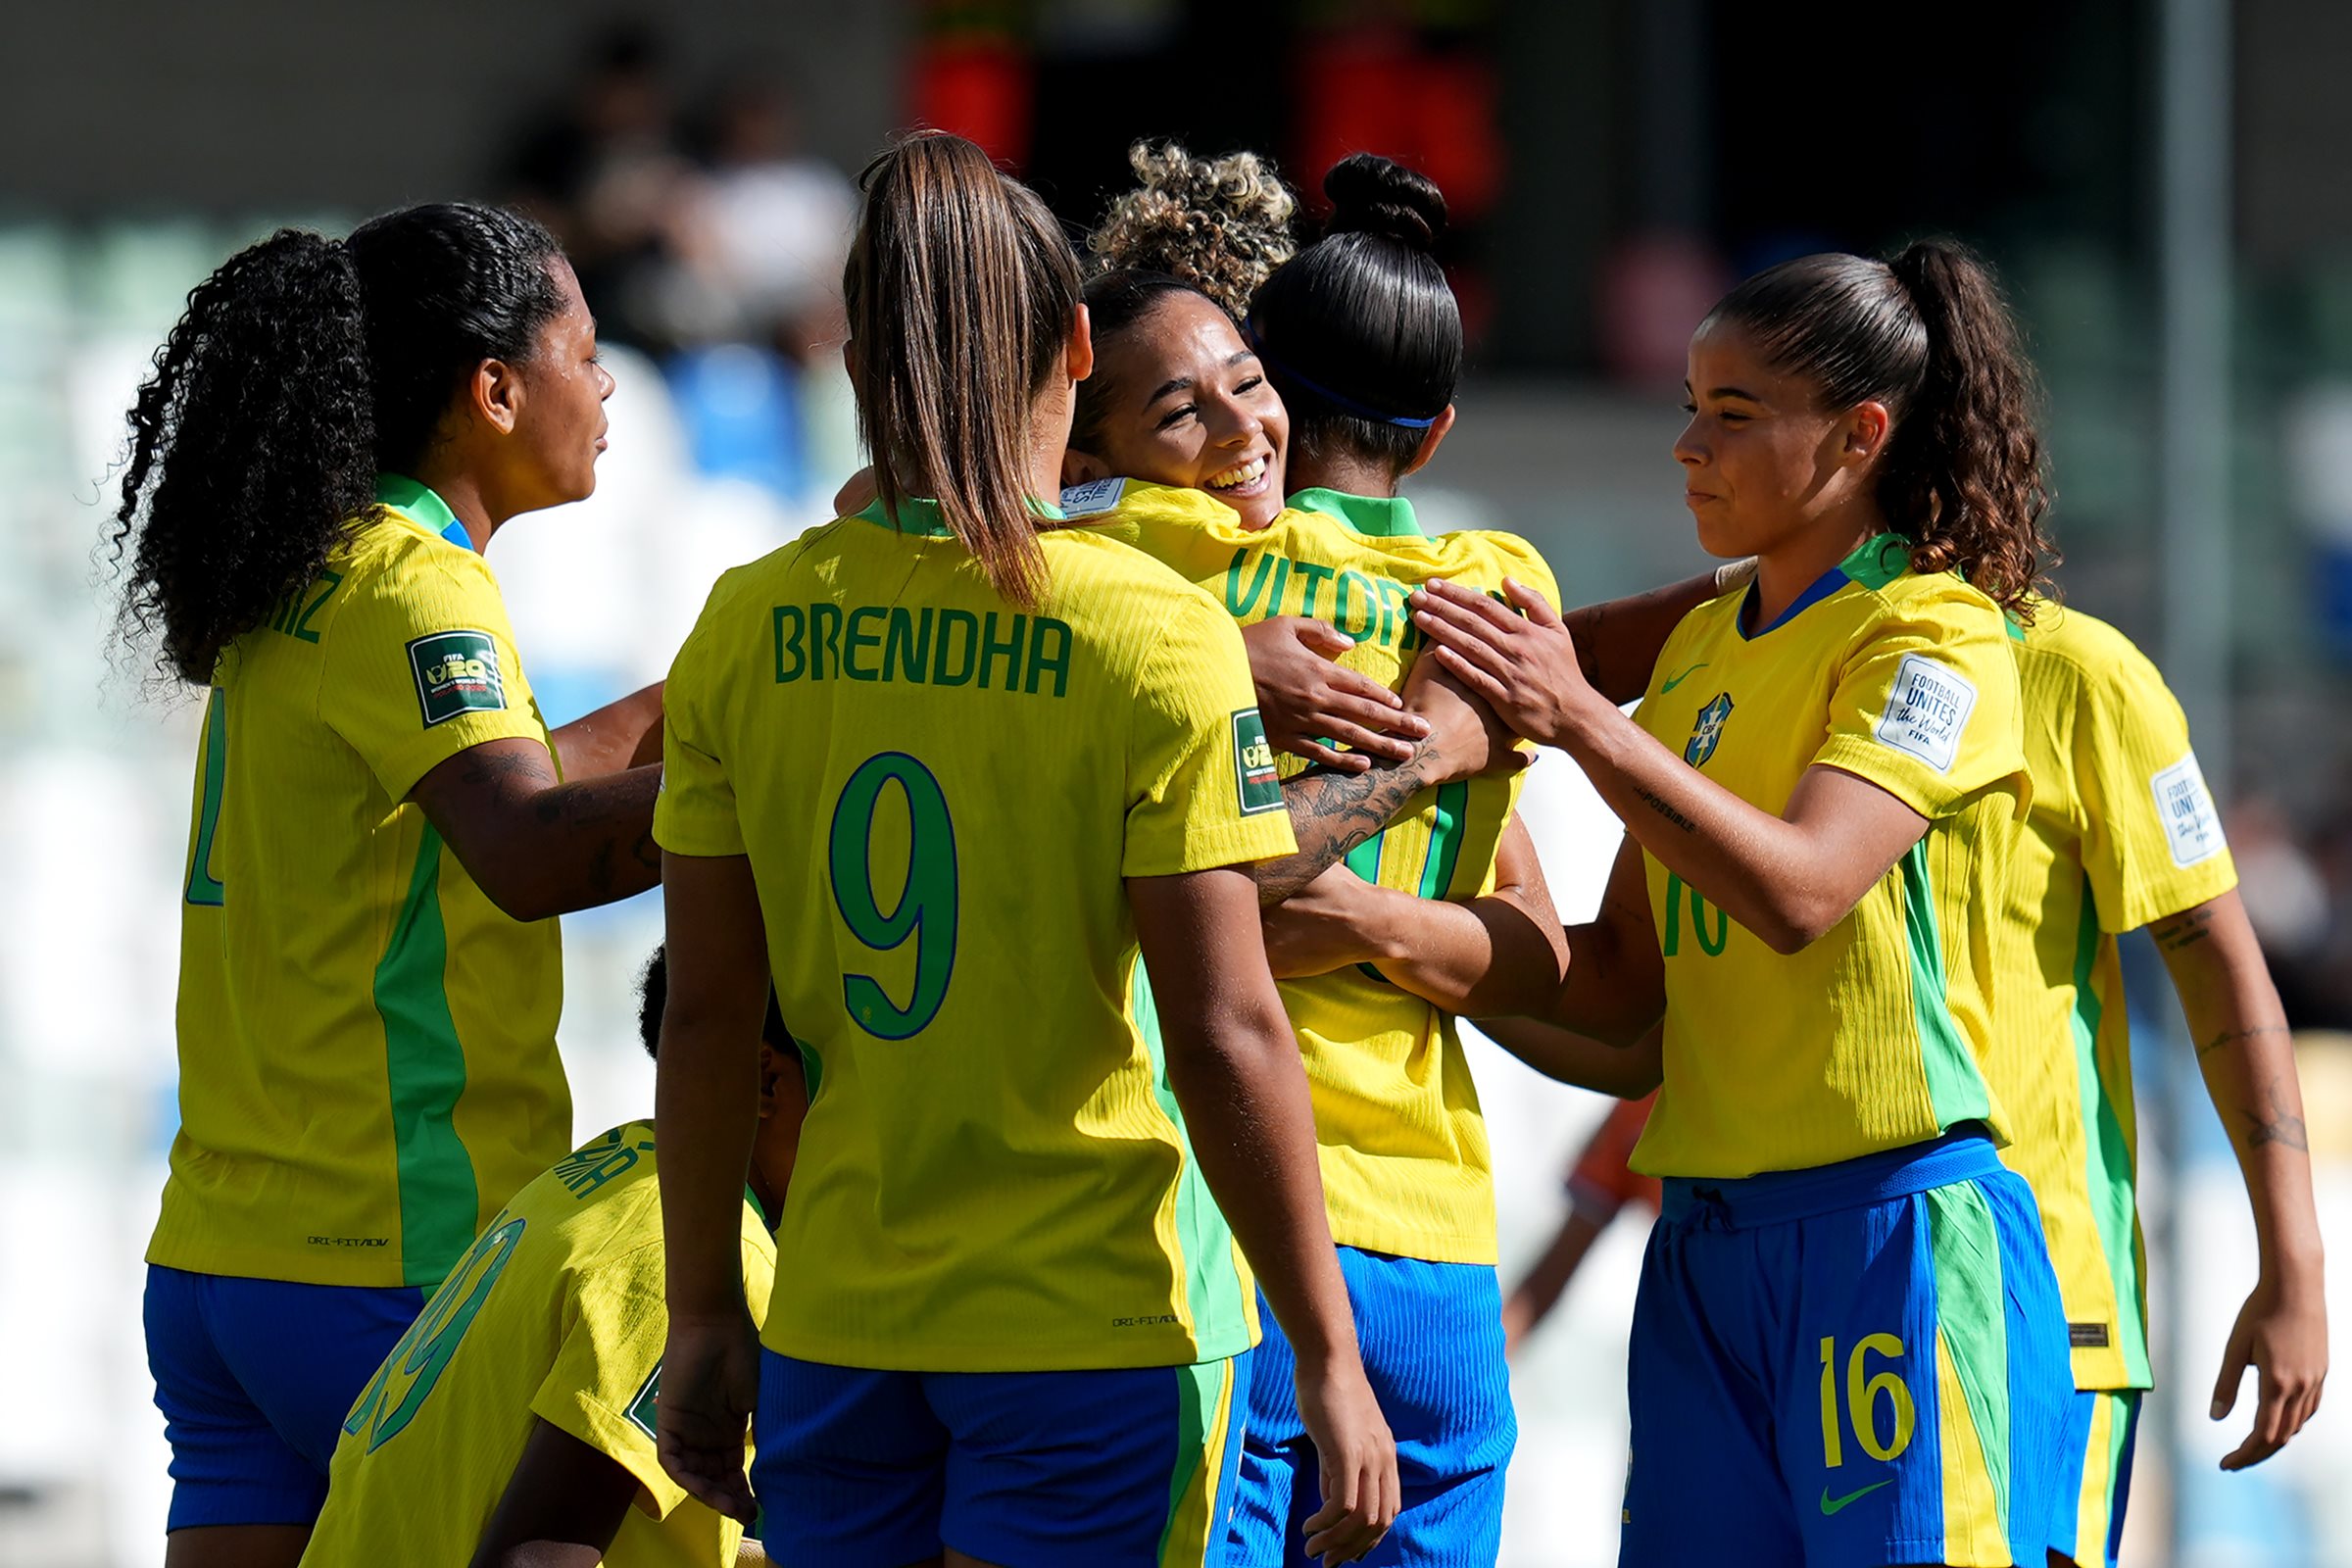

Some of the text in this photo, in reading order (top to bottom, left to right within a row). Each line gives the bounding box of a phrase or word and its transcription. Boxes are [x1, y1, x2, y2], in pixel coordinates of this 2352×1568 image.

[773, 603, 1072, 698] BRENDHA
[1906, 687, 1956, 726] UNITES
[1911, 672, 1960, 710] FOOTBALL
[1896, 707, 1951, 745] the World
[1908, 729, 1930, 745] FIFA
[829, 751, 958, 1041] 9
[1820, 1333, 1915, 1468] 16
